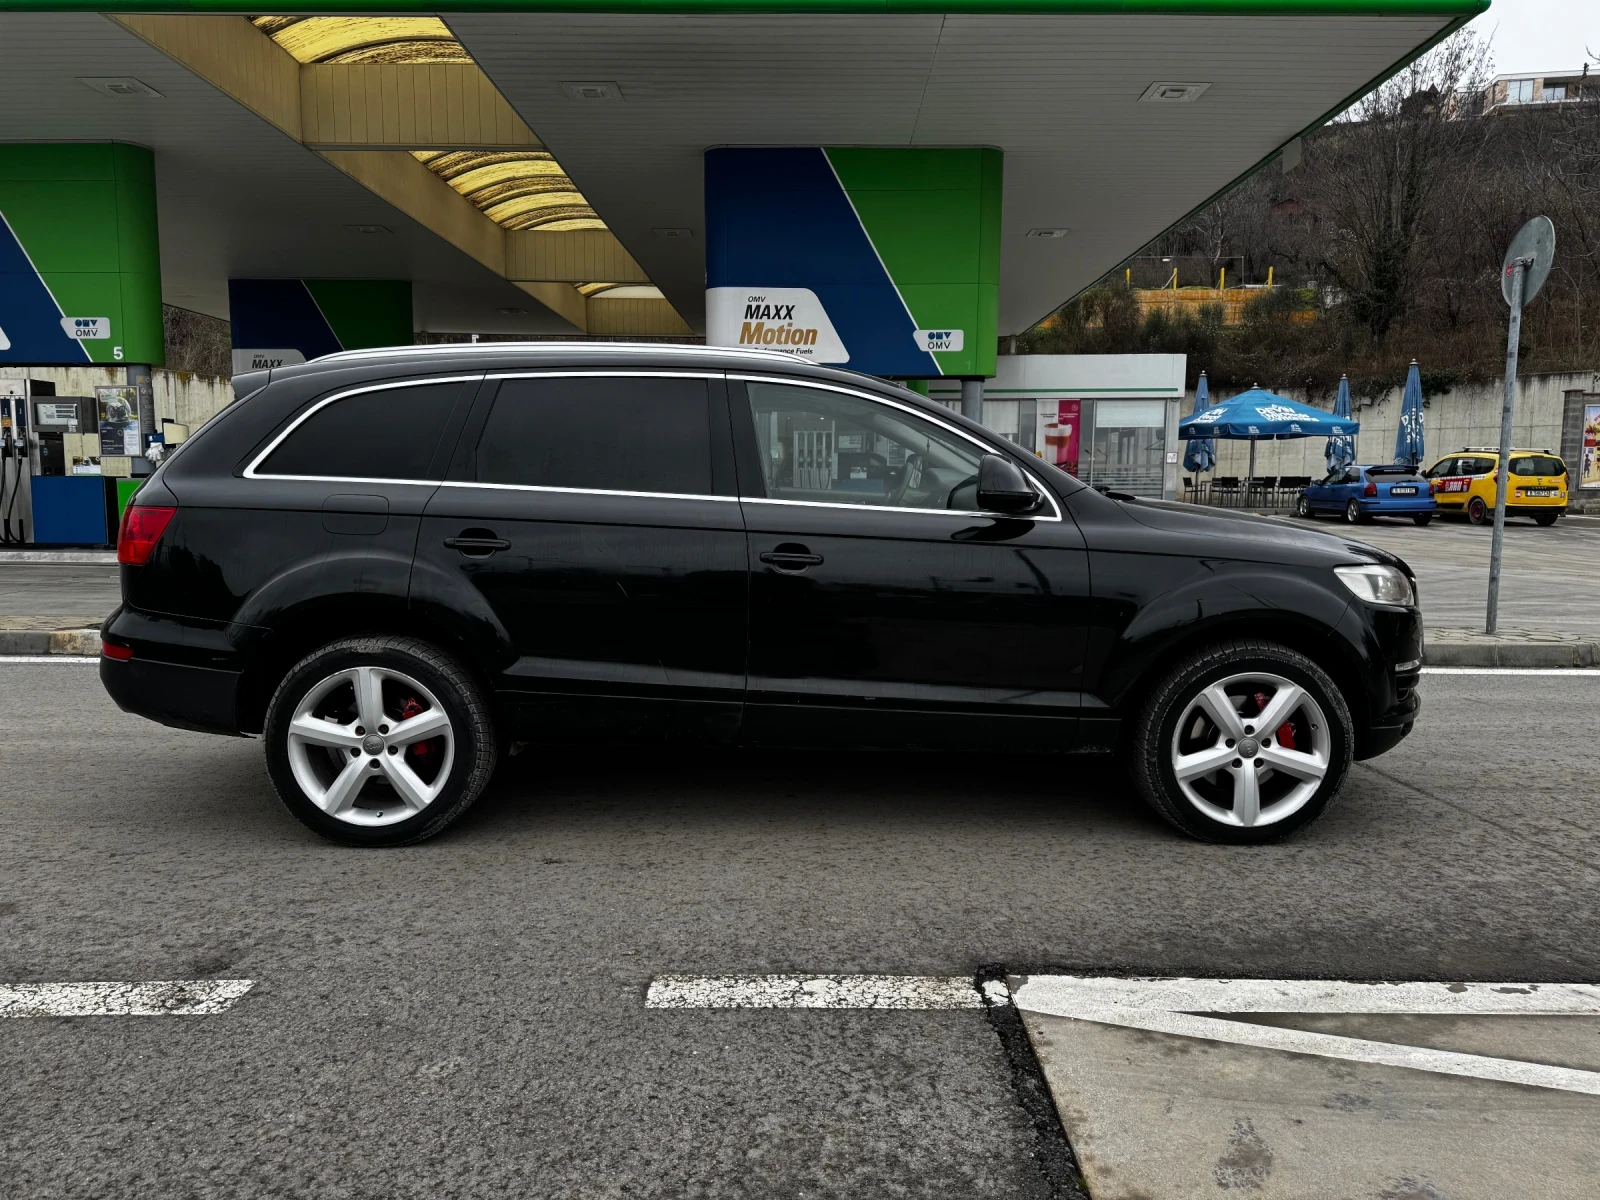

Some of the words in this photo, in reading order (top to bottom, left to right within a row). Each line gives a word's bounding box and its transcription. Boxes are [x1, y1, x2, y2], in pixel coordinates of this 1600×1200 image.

[744, 304, 796, 320] MAXX
[75, 329, 98, 337] OMV
[739, 322, 818, 346] Motion
[928, 341, 951, 350] OMV
[113, 346, 124, 360] 5
[252, 359, 283, 369] MAXX
